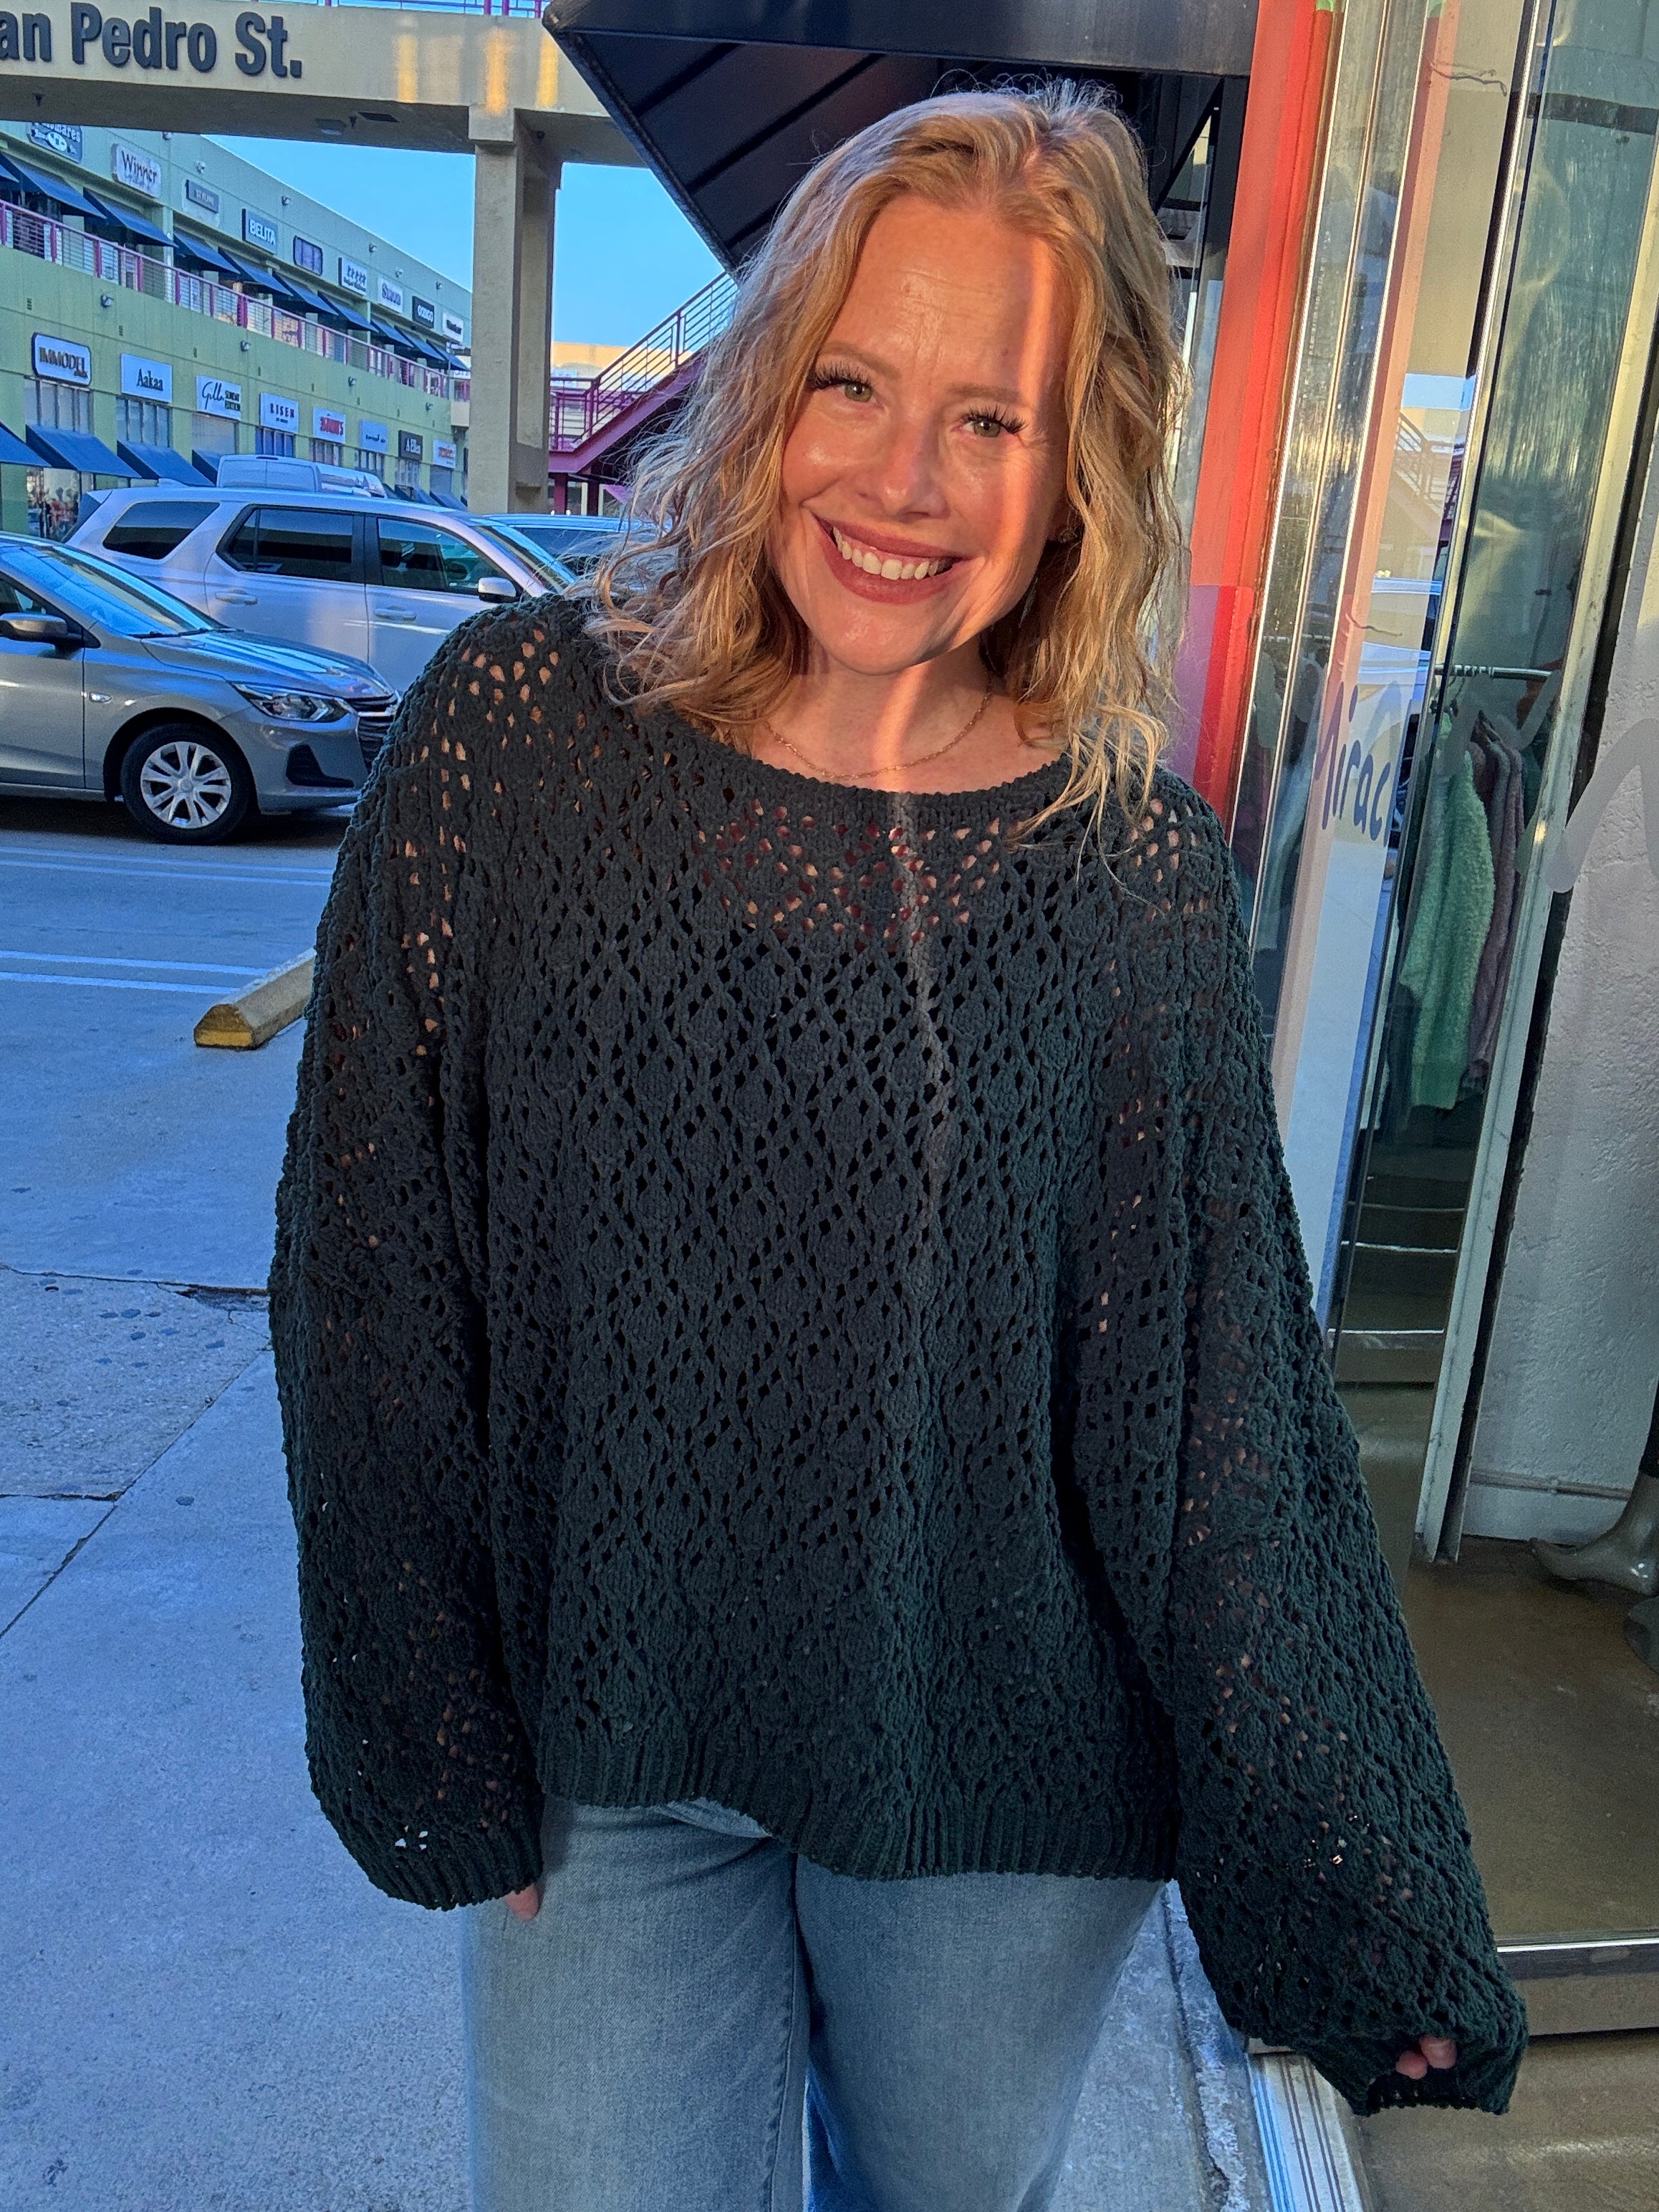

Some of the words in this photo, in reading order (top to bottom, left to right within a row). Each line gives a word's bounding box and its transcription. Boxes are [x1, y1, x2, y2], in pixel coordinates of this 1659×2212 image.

[71, 1, 217, 73] Pedro
[234, 11, 302, 79] St.
[121, 150, 157, 184] Winner
[249, 218, 276, 245] BELITA
[136, 368, 163, 392] Aakaa
